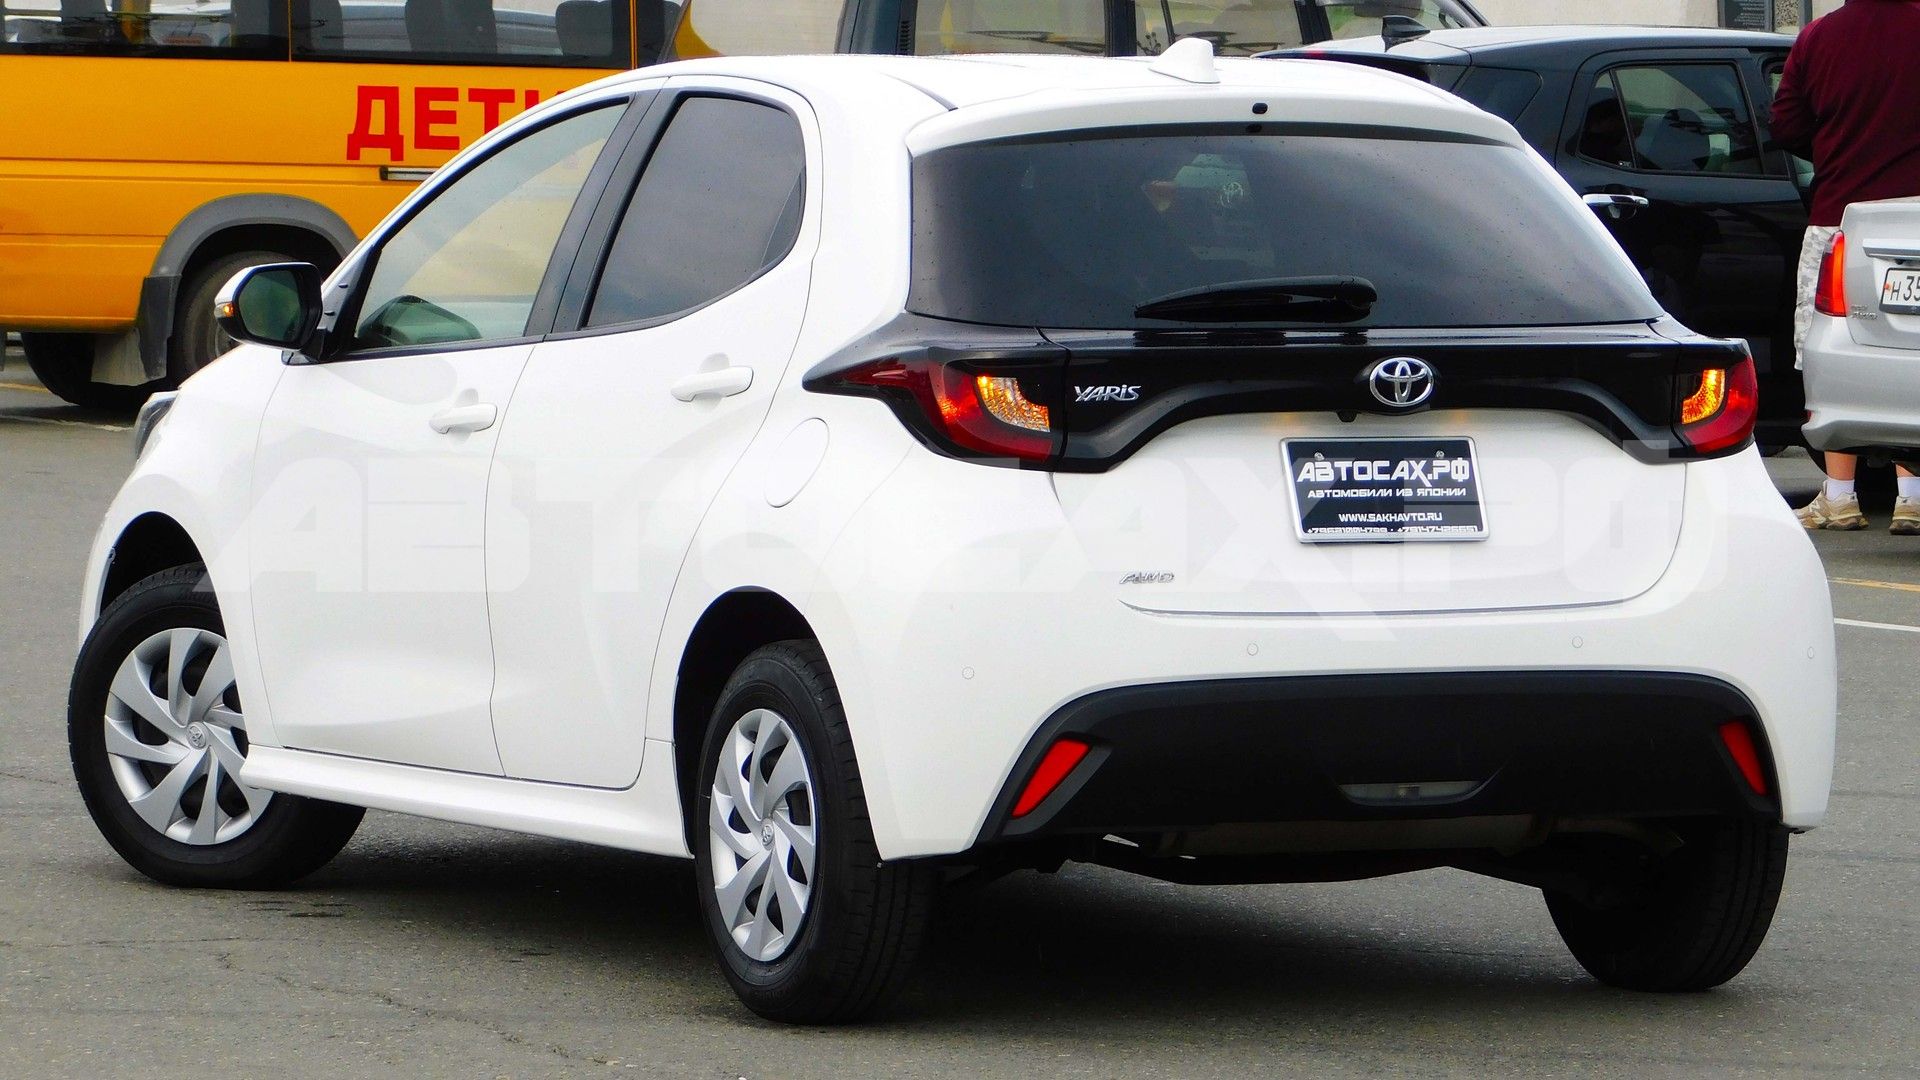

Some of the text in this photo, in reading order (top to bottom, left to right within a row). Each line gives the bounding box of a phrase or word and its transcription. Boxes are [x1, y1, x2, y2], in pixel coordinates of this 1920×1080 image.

[346, 85, 566, 162] ДЕТ
[1297, 457, 1470, 487] АВТОСАХ.РФ
[1307, 488, 1467, 498] АВТОМОБИЛИ ИЗ ЯПОНИИ
[1338, 512, 1443, 523] WWW.SAKHAVTO.RU
